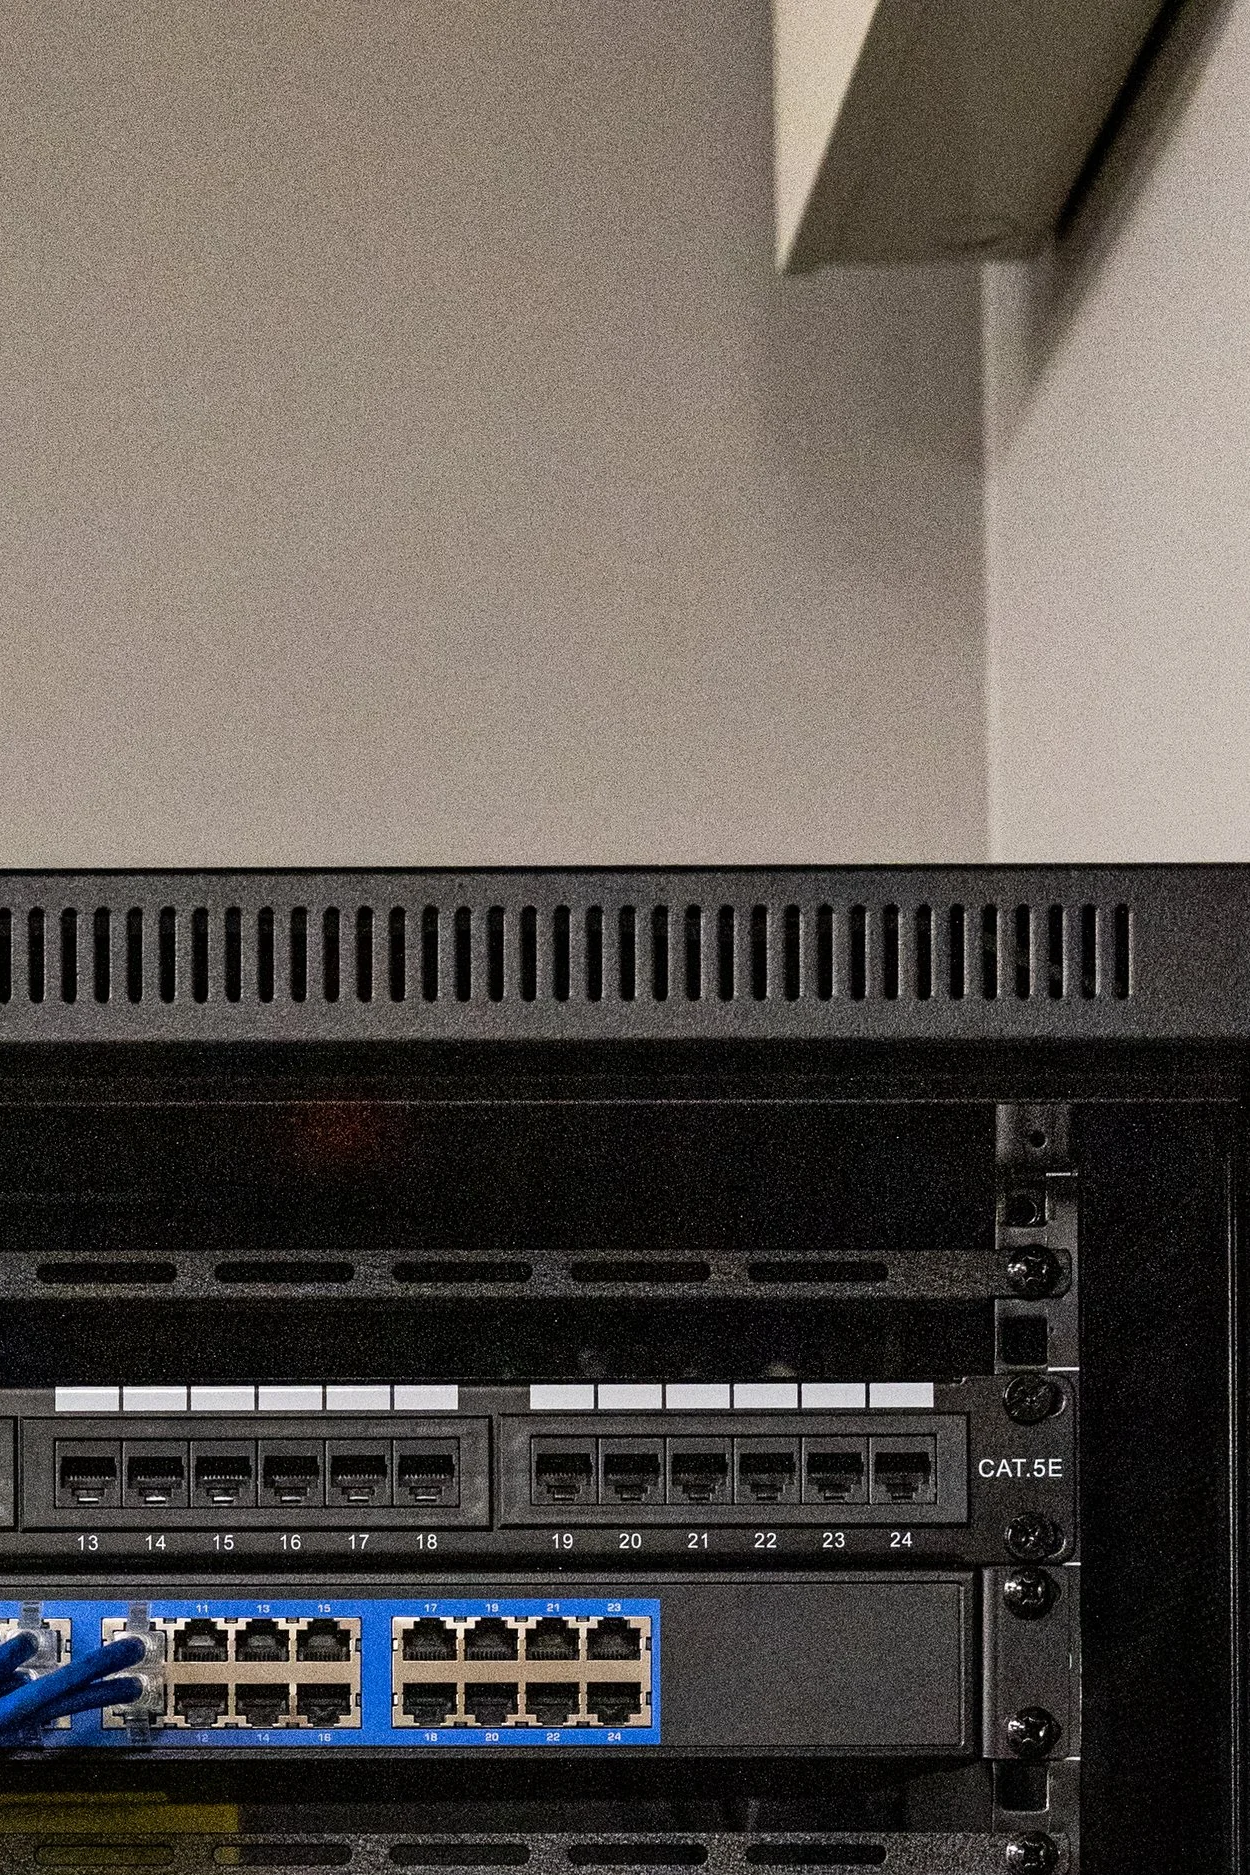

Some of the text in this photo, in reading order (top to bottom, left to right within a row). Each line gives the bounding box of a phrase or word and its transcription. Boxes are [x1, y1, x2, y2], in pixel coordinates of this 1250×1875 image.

[978, 1458, 1063, 1478] CAT.5E
[77, 1534, 99, 1551] 13
[145, 1534, 167, 1550] 14
[212, 1533, 235, 1551] 15
[280, 1533, 302, 1551] 16
[348, 1533, 370, 1550] 17
[416, 1533, 438, 1550] 18
[551, 1532, 574, 1550] 19
[618, 1532, 642, 1549] 20
[687, 1532, 708, 1549] 21
[754, 1531, 777, 1549] 22
[822, 1531, 846, 1549] 23
[889, 1531, 913, 1548] 24
[196, 1604, 209, 1613] 11
[257, 1604, 270, 1614] 13
[317, 1603, 331, 1613] 15
[424, 1602, 438, 1612] 17
[485, 1603, 499, 1613] 19
[546, 1602, 560, 1613] 21
[607, 1602, 622, 1612] 23
[257, 1733, 270, 1742] 14
[424, 1732, 438, 1742] 18
[485, 1732, 499, 1742] 20
[546, 1732, 560, 1742] 22
[607, 1732, 622, 1742] 24
